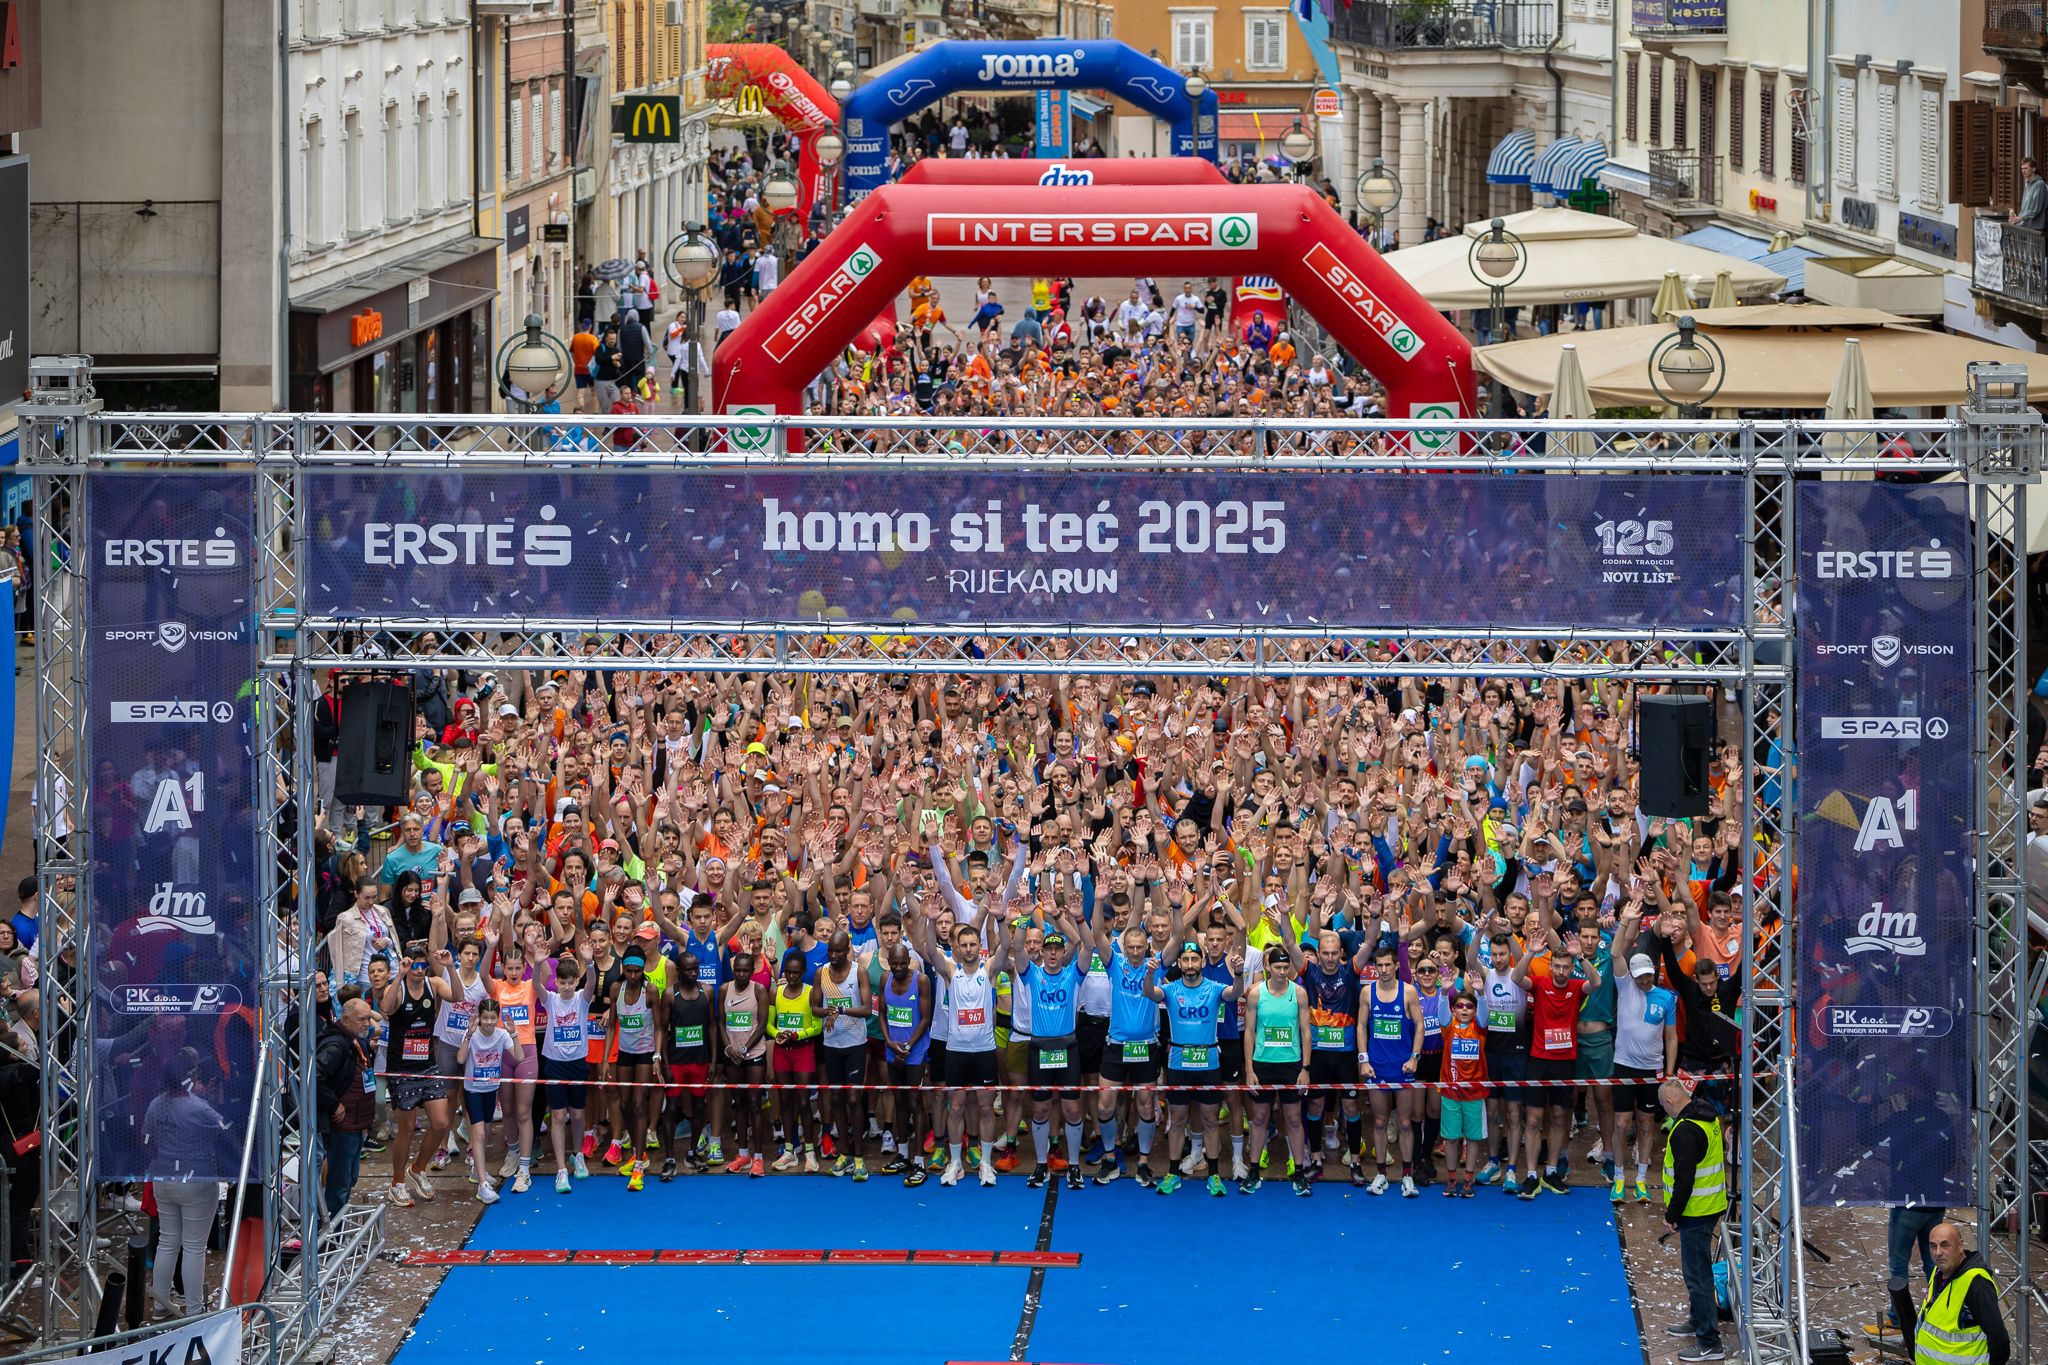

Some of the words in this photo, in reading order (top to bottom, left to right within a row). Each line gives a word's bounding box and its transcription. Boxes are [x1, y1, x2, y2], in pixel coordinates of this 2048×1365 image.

[1672, 8, 1725, 17] HOSTEL
[959, 222, 1210, 242] INTERSPAR
[1326, 265, 1394, 333] SPAR
[785, 273, 853, 340] SPAR
[762, 498, 931, 552] homo
[950, 499, 1005, 552] si
[1021, 499, 1119, 553] teć
[1138, 500, 1286, 554] 2025
[1594, 520, 1674, 556] 125
[364, 522, 515, 566] ERSTE
[105, 539, 200, 566] ERSTE
[1816, 551, 1915, 579] ERSTE
[1602, 571, 1639, 583] NOVI
[1642, 572, 1674, 584] LIST
[105, 631, 155, 640] SPORT
[189, 631, 238, 640] VISION
[1816, 644, 1868, 655] SPORT
[1902, 644, 1954, 655] VISION
[130, 704, 206, 718] SPAR
[1841, 720, 1919, 735] SPAR
[143, 771, 205, 833] A1
[1853, 788, 1917, 852] A1
[149, 882, 206, 916] dm
[1857, 901, 1917, 937] dm
[699, 968, 716, 977] 1555
[126, 988, 150, 1001] PK
[153, 994, 180, 1002] d.o.o.
[1040, 989, 1067, 1003] CRO
[510, 1008, 528, 1018] 1441
[896, 1011, 909, 1020] 446
[968, 1012, 982, 1022] 967
[1178, 1006, 1209, 1019] CRO
[1832, 1009, 1857, 1024] PK
[627, 1017, 640, 1026] 443
[735, 1015, 749, 1024] 442
[787, 1017, 801, 1026] 447
[1498, 1016, 1508, 1026] 43
[1384, 1023, 1398, 1033] 415
[562, 1029, 580, 1039] 1307
[686, 1030, 700, 1039] 444
[1276, 1031, 1289, 1040] 194
[1328, 1031, 1342, 1040] 190
[1554, 1031, 1571, 1041] 1112
[413, 1042, 429, 1052] 1055
[1133, 1046, 1146, 1055] 414
[1461, 1043, 1478, 1052] 1577
[1050, 1052, 1064, 1062] 235
[1192, 1052, 1206, 1061] 276
